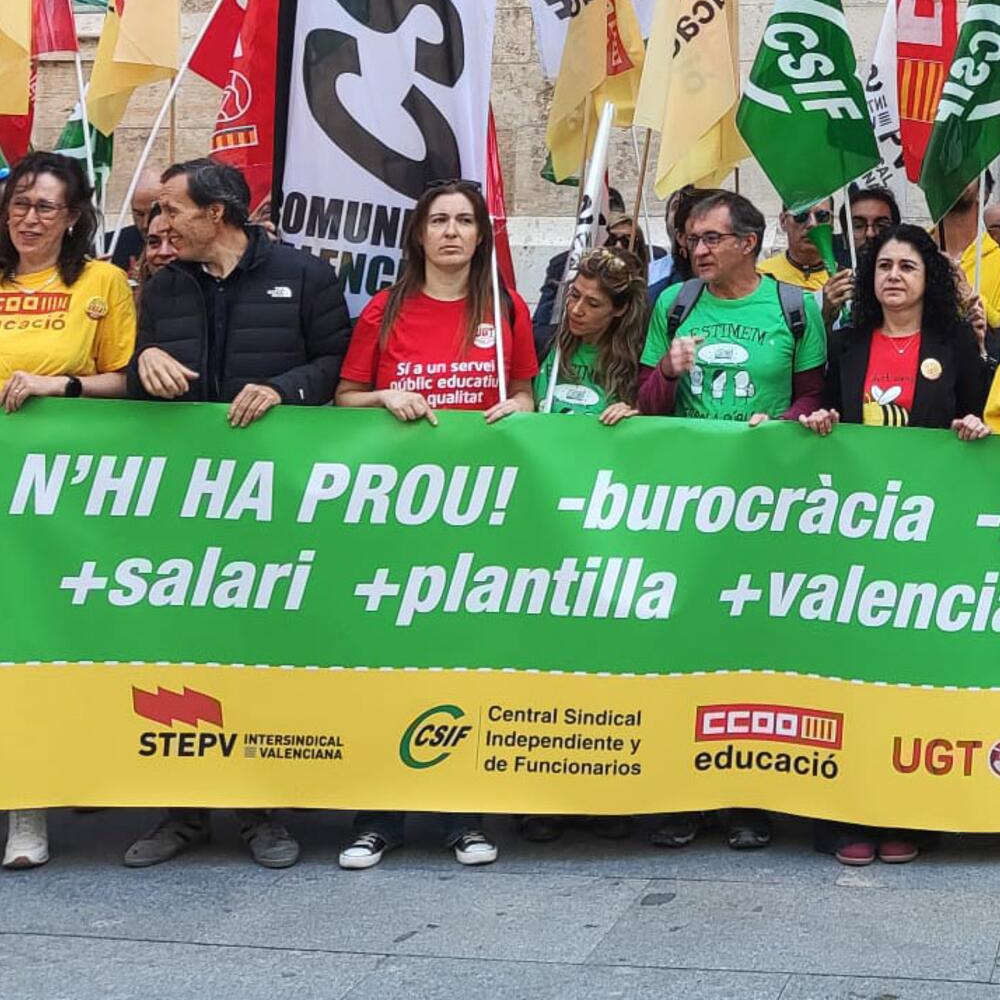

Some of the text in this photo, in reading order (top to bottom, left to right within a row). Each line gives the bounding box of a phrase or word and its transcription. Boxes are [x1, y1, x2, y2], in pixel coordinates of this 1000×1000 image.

[763, 22, 863, 120] CSIF
[413, 364, 423, 375] a
[427, 362, 447, 374] un
[451, 359, 496, 373] servei
[179, 457, 275, 522] HA
[299, 462, 519, 527] PROU!
[557, 469, 936, 542] -burocràcia
[60, 546, 317, 611] +salari
[354, 552, 678, 627] +plantilla
[488, 705, 642, 726] Central Sindical
[702, 710, 798, 737] CCOO
[138, 731, 344, 758] STEPV INTERSINDICAL
[414, 723, 473, 748] CSIF
[486, 730, 642, 755] Independiente y
[260, 747, 343, 760] VALENCIANA
[483, 756, 642, 776] de Funcionarios
[694, 744, 839, 780] educació
[892, 736, 984, 777] UGT
